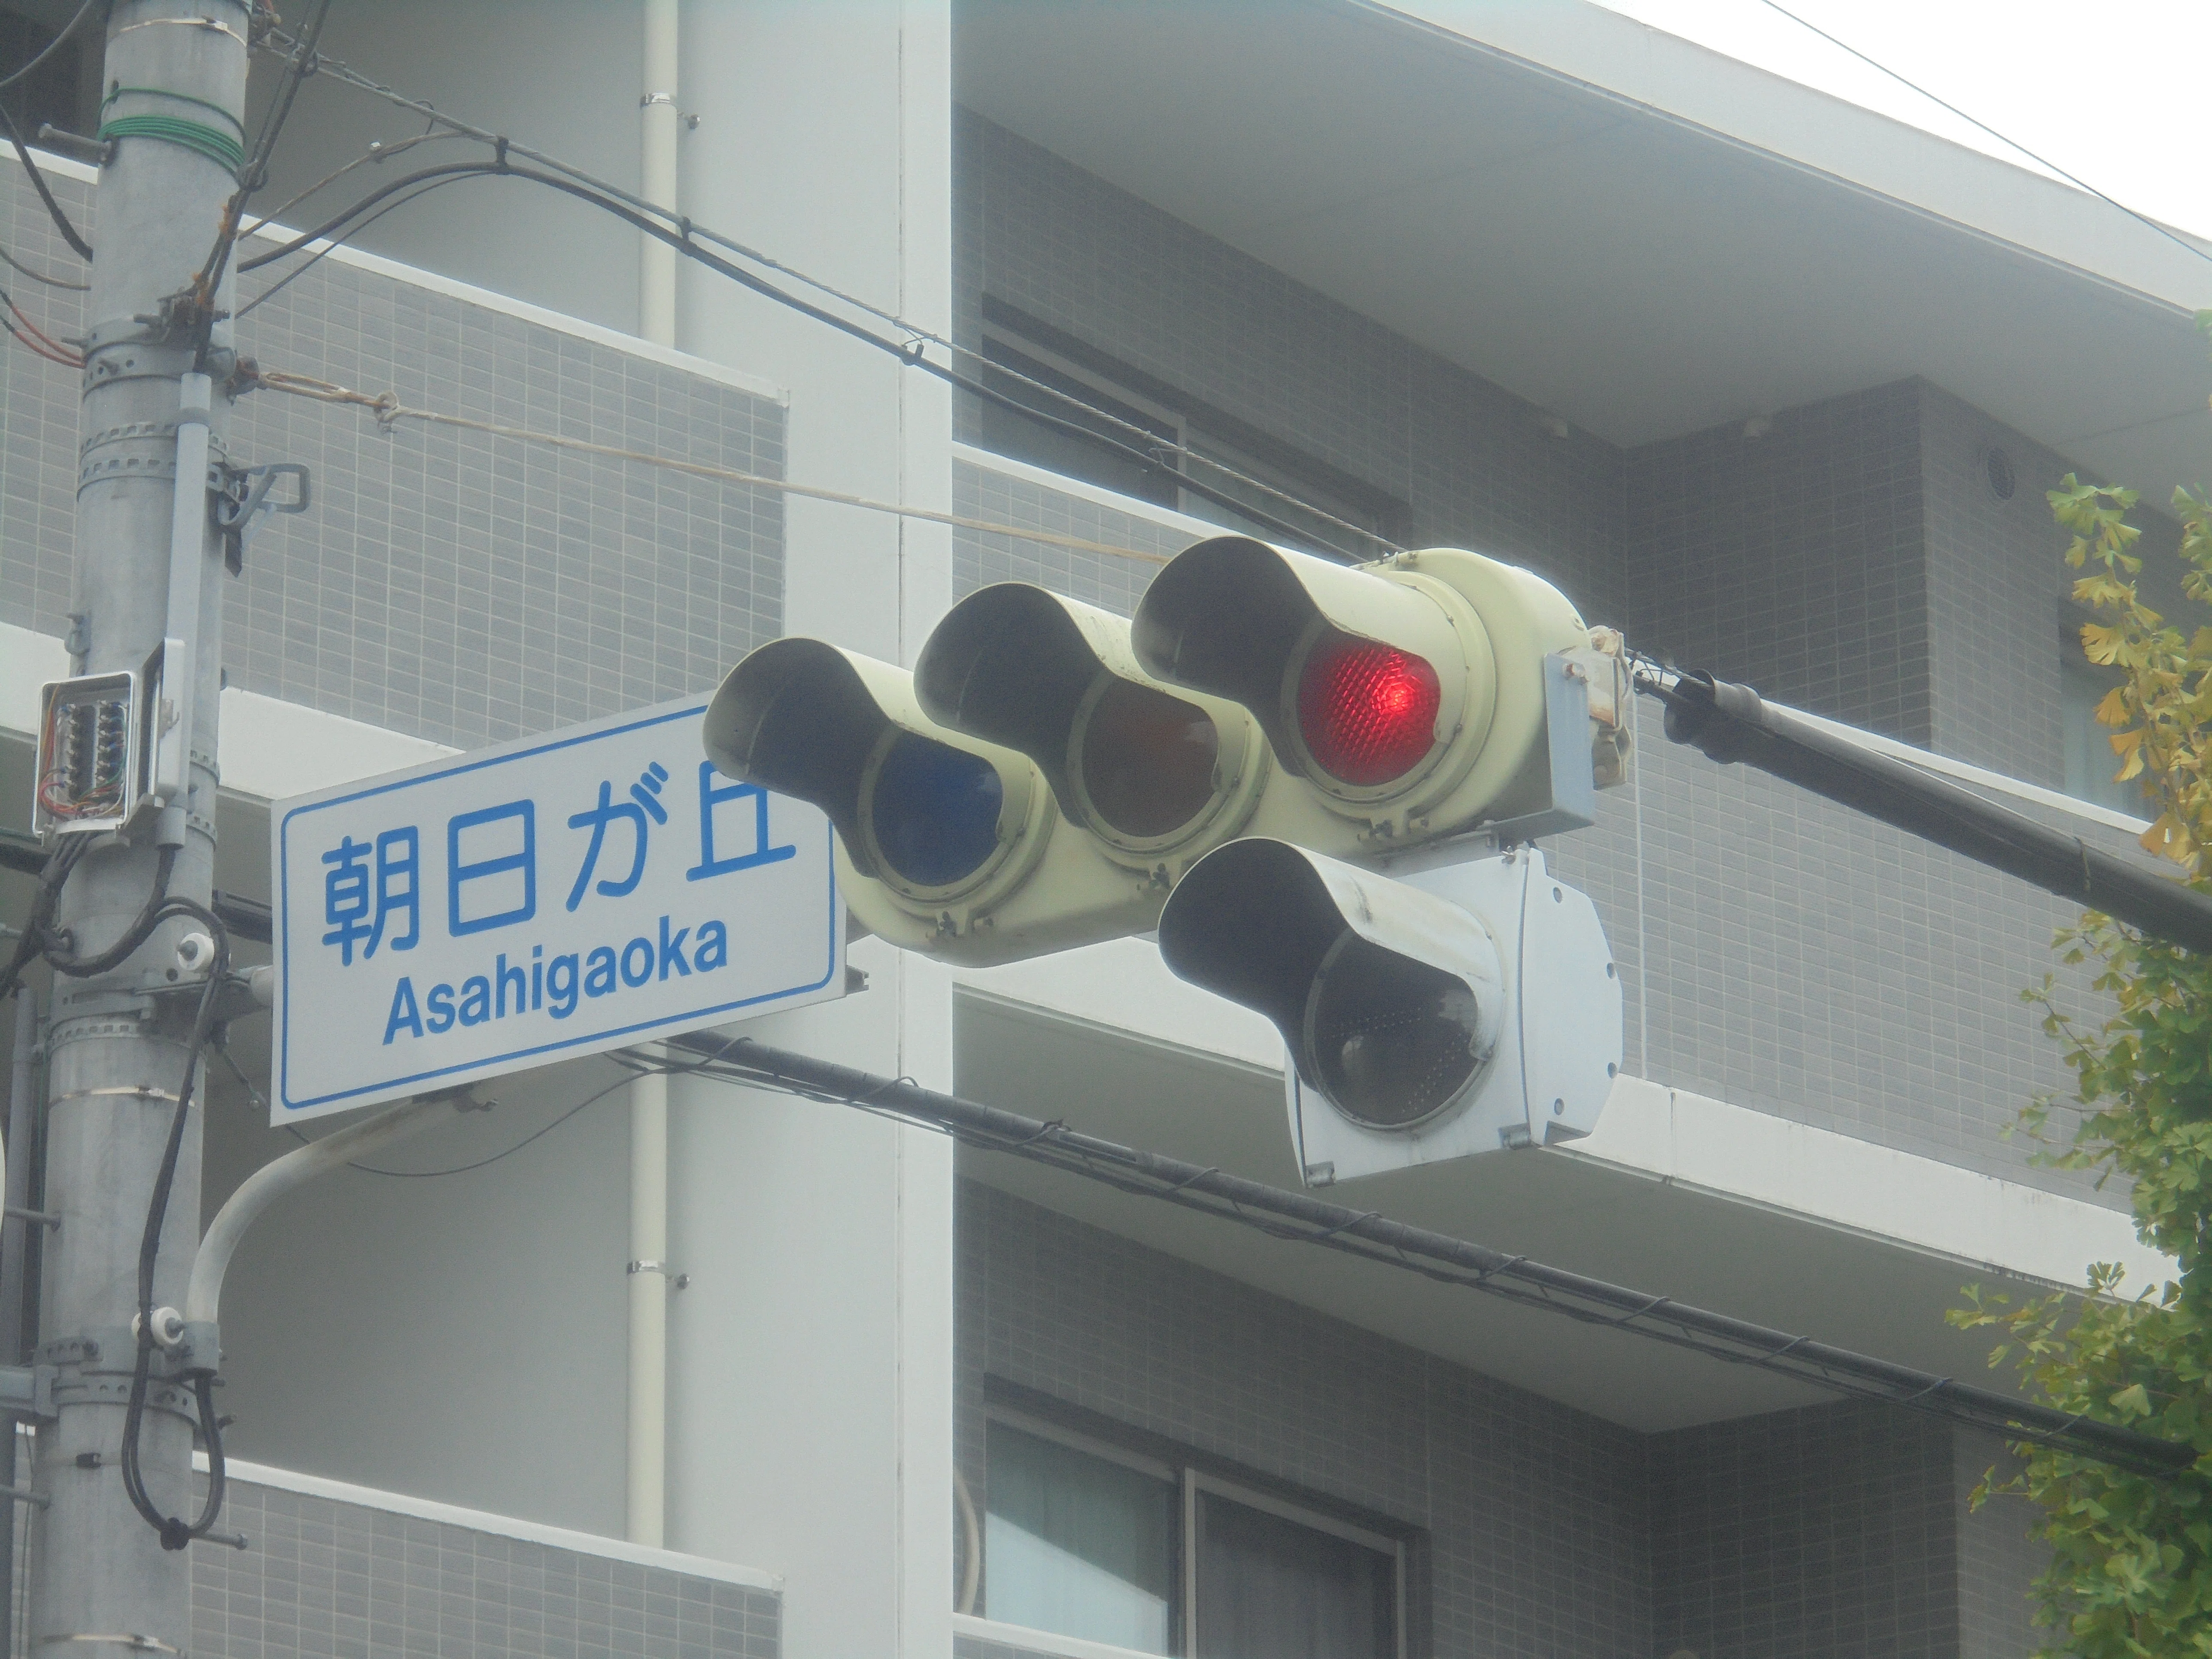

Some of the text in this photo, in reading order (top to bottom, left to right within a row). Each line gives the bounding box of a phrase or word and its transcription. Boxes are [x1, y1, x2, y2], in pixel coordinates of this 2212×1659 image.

[322, 760, 796, 966] 朝日が丘
[383, 915, 727, 1045] Asahigaoka
